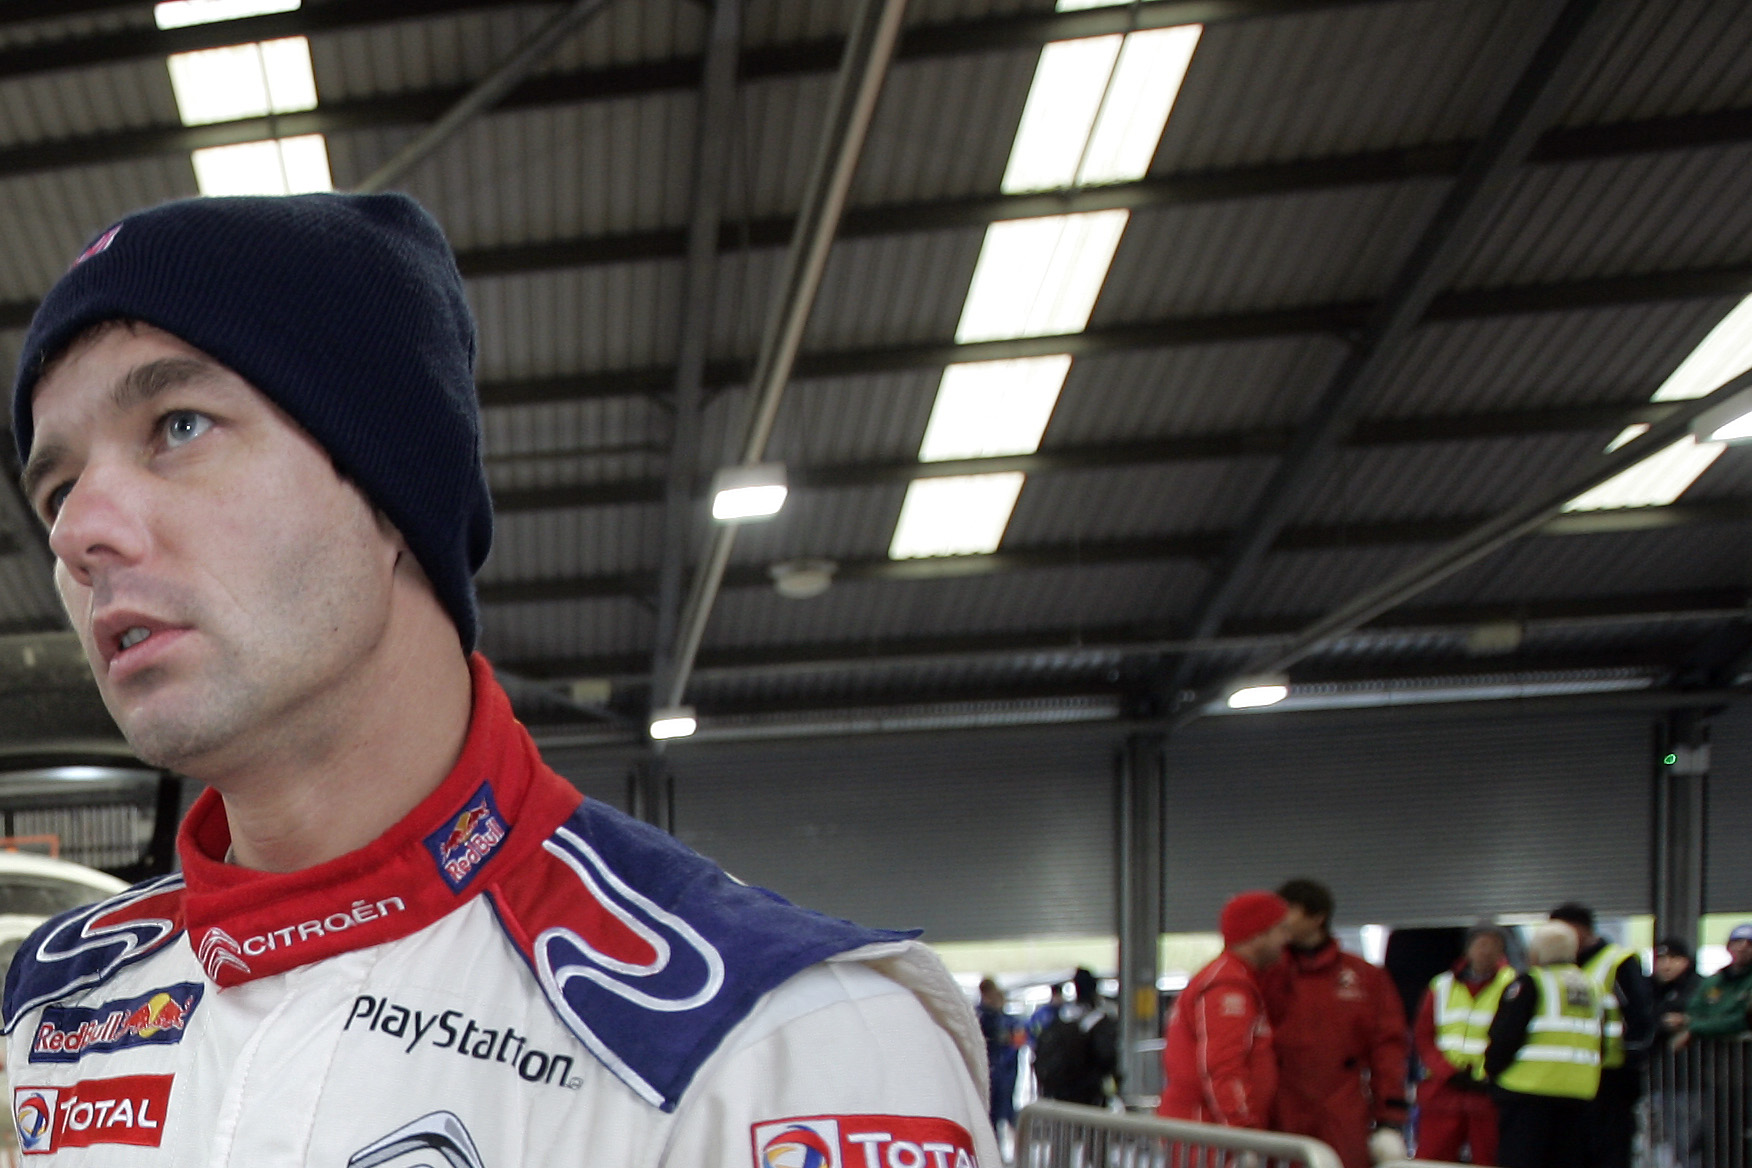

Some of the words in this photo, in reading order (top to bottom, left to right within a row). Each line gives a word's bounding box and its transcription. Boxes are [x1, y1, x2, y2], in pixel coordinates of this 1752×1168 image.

[445, 842, 481, 883] Red
[470, 816, 505, 855] Bull
[34, 1021, 88, 1054] Red
[344, 994, 574, 1088] PlayStation
[60, 1096, 158, 1134] TOTAL
